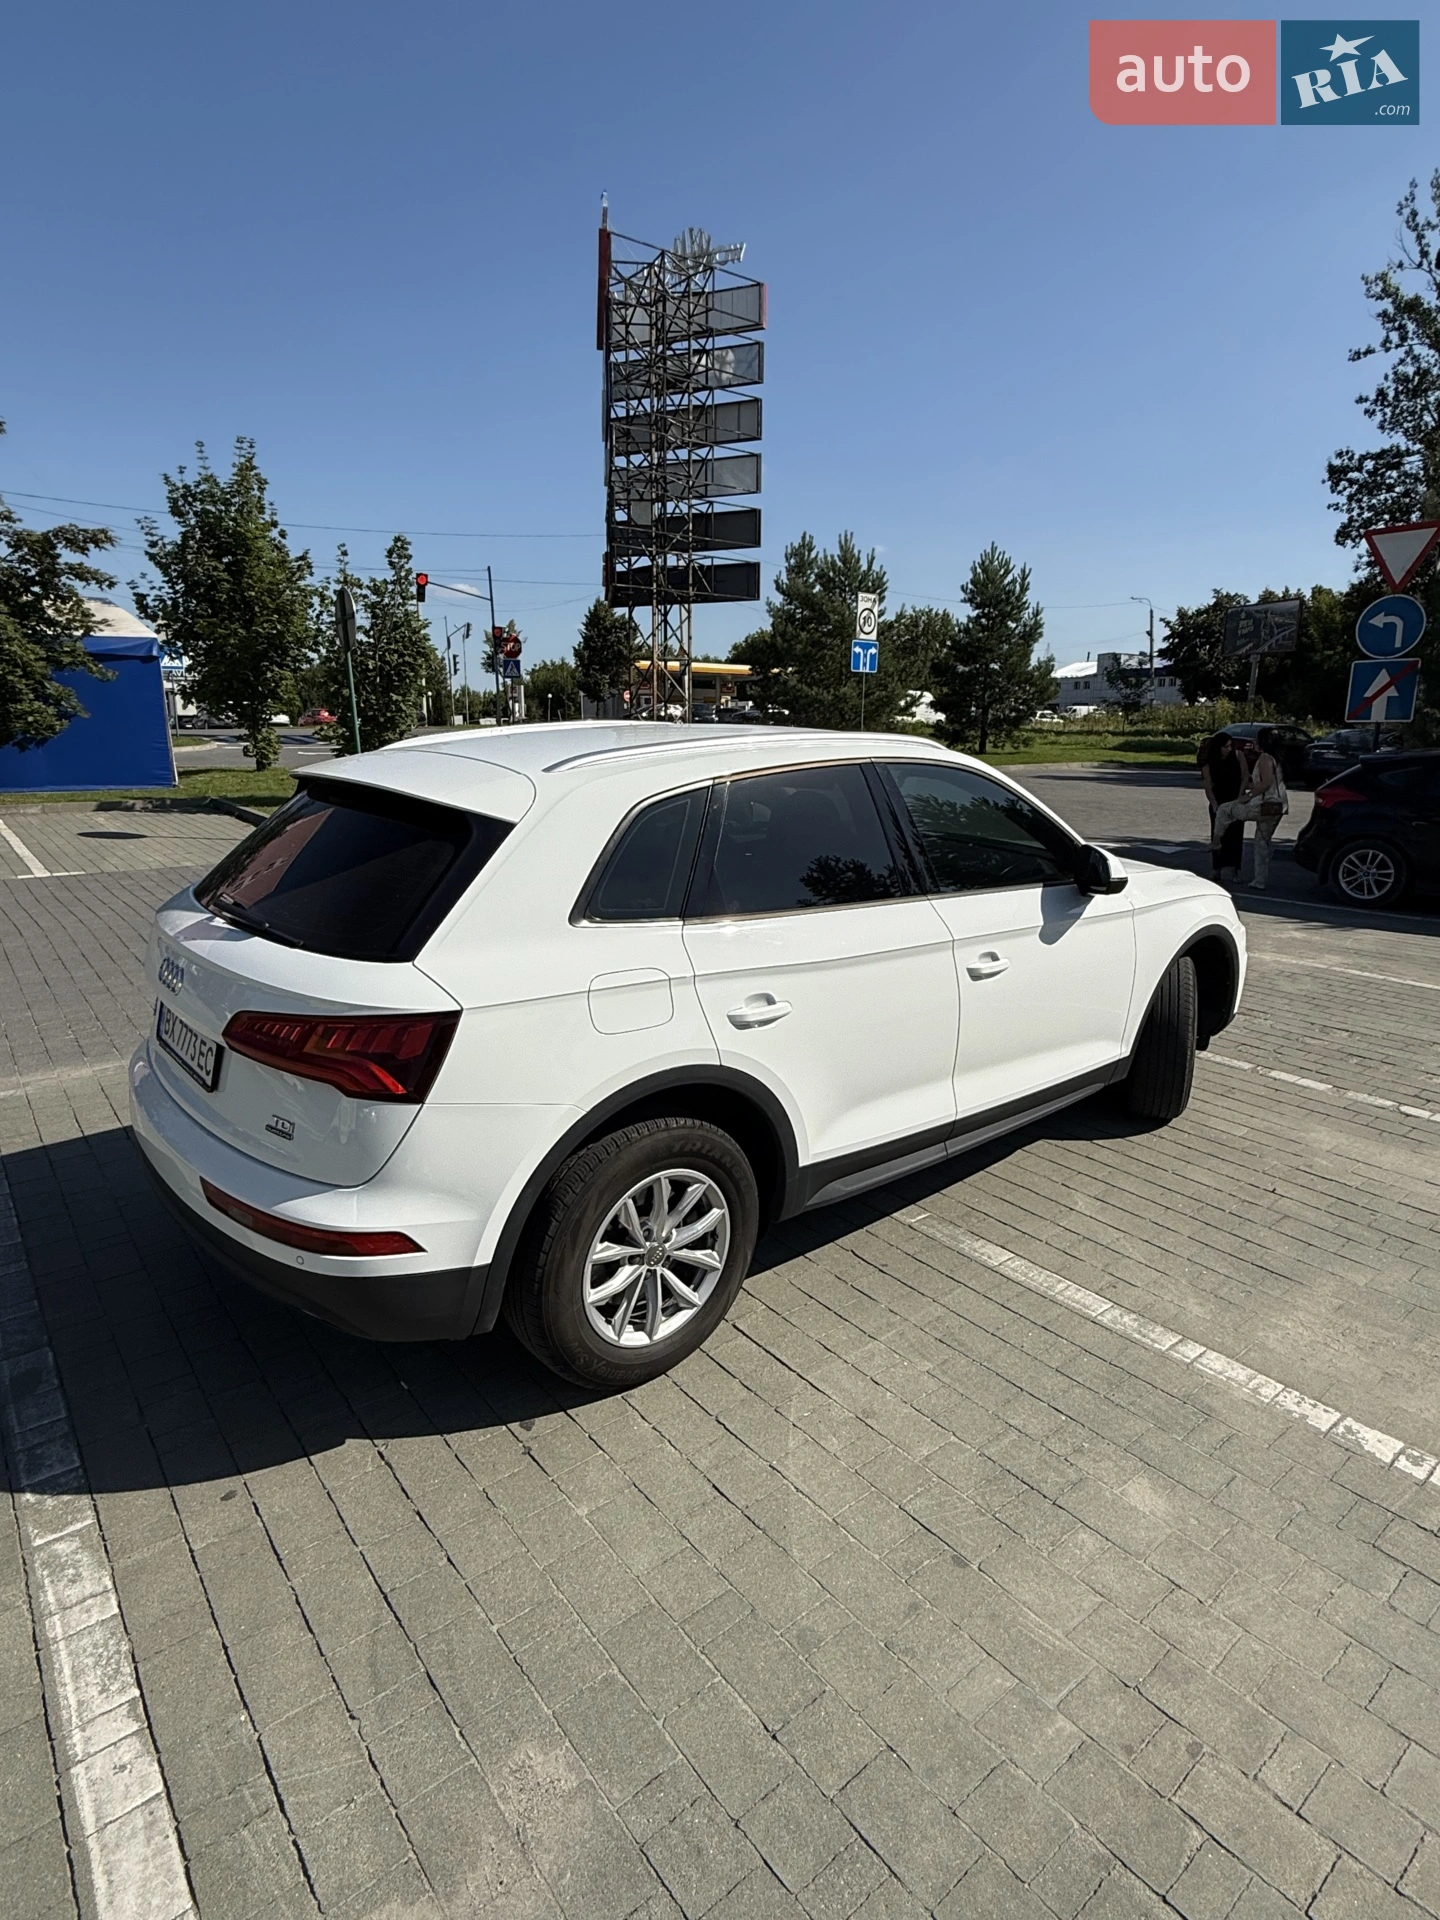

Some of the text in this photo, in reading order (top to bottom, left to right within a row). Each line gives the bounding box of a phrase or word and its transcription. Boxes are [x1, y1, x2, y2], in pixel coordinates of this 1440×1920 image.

[860, 595, 877, 604] ЗОНА
[862, 615, 873, 628] 10
[501, 641, 521, 652] STOP
